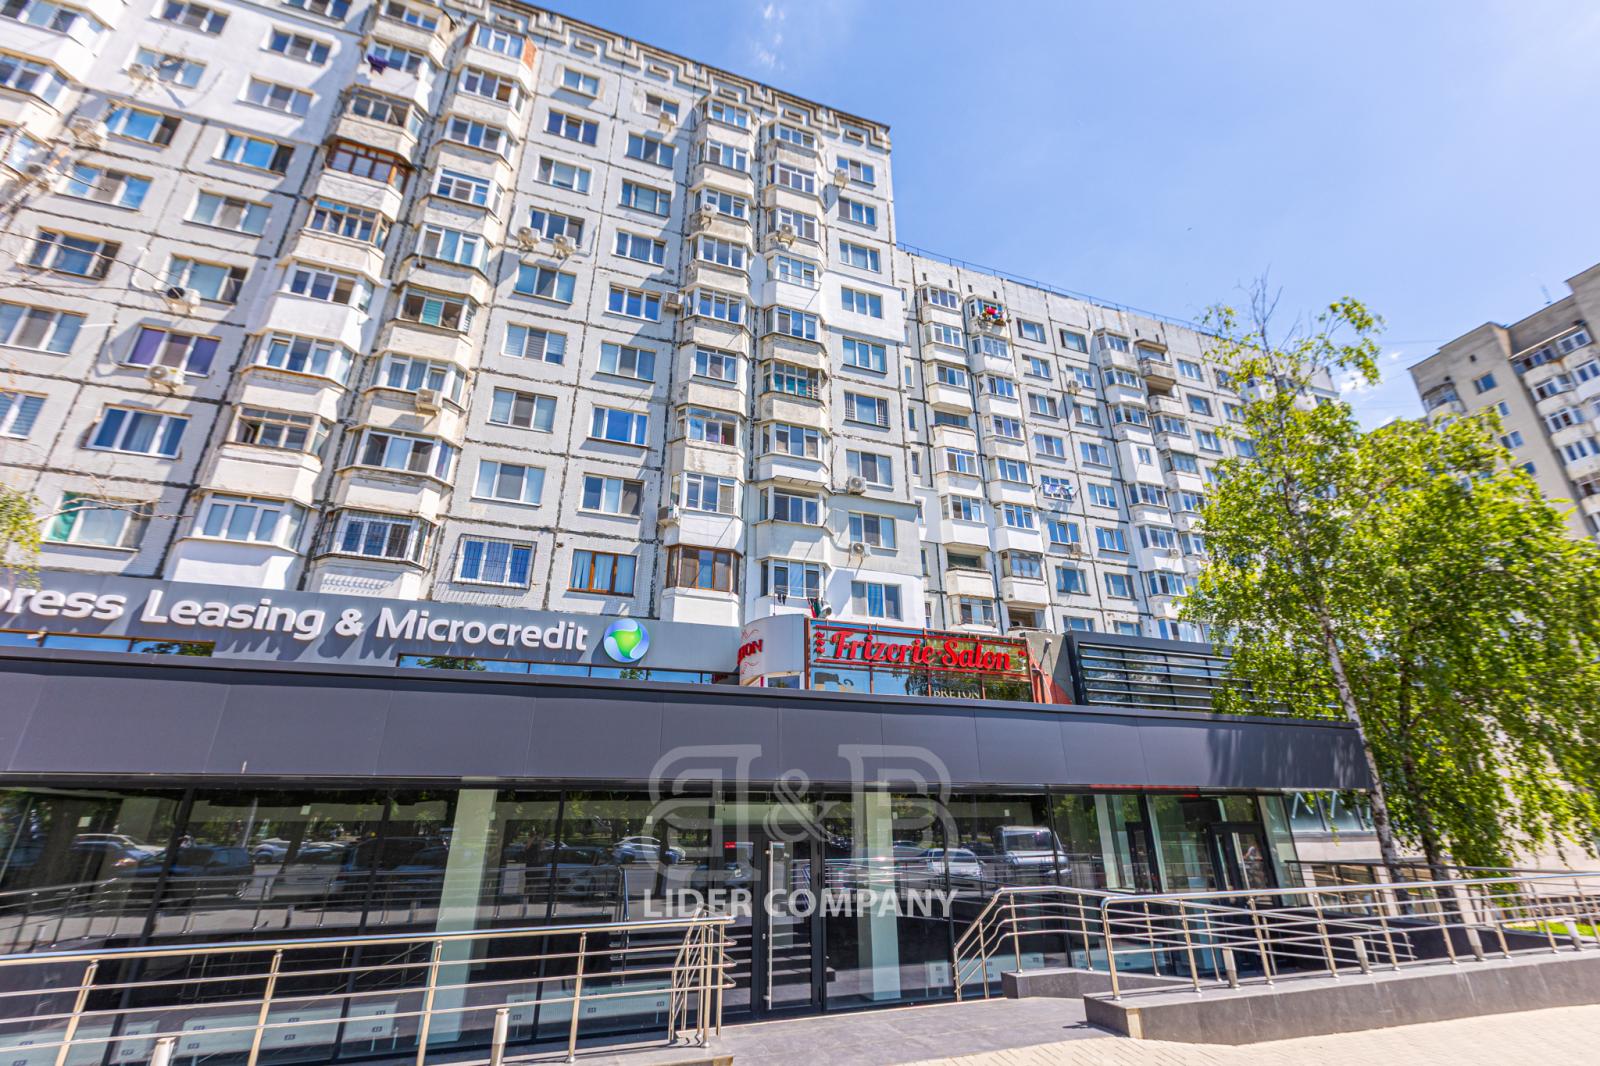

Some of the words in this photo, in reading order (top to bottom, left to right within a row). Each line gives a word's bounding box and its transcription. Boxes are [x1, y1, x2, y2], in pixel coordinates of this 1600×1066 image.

[141, 589, 325, 641] Leasing
[334, 607, 364, 638] &
[375, 606, 589, 650] Microcredit
